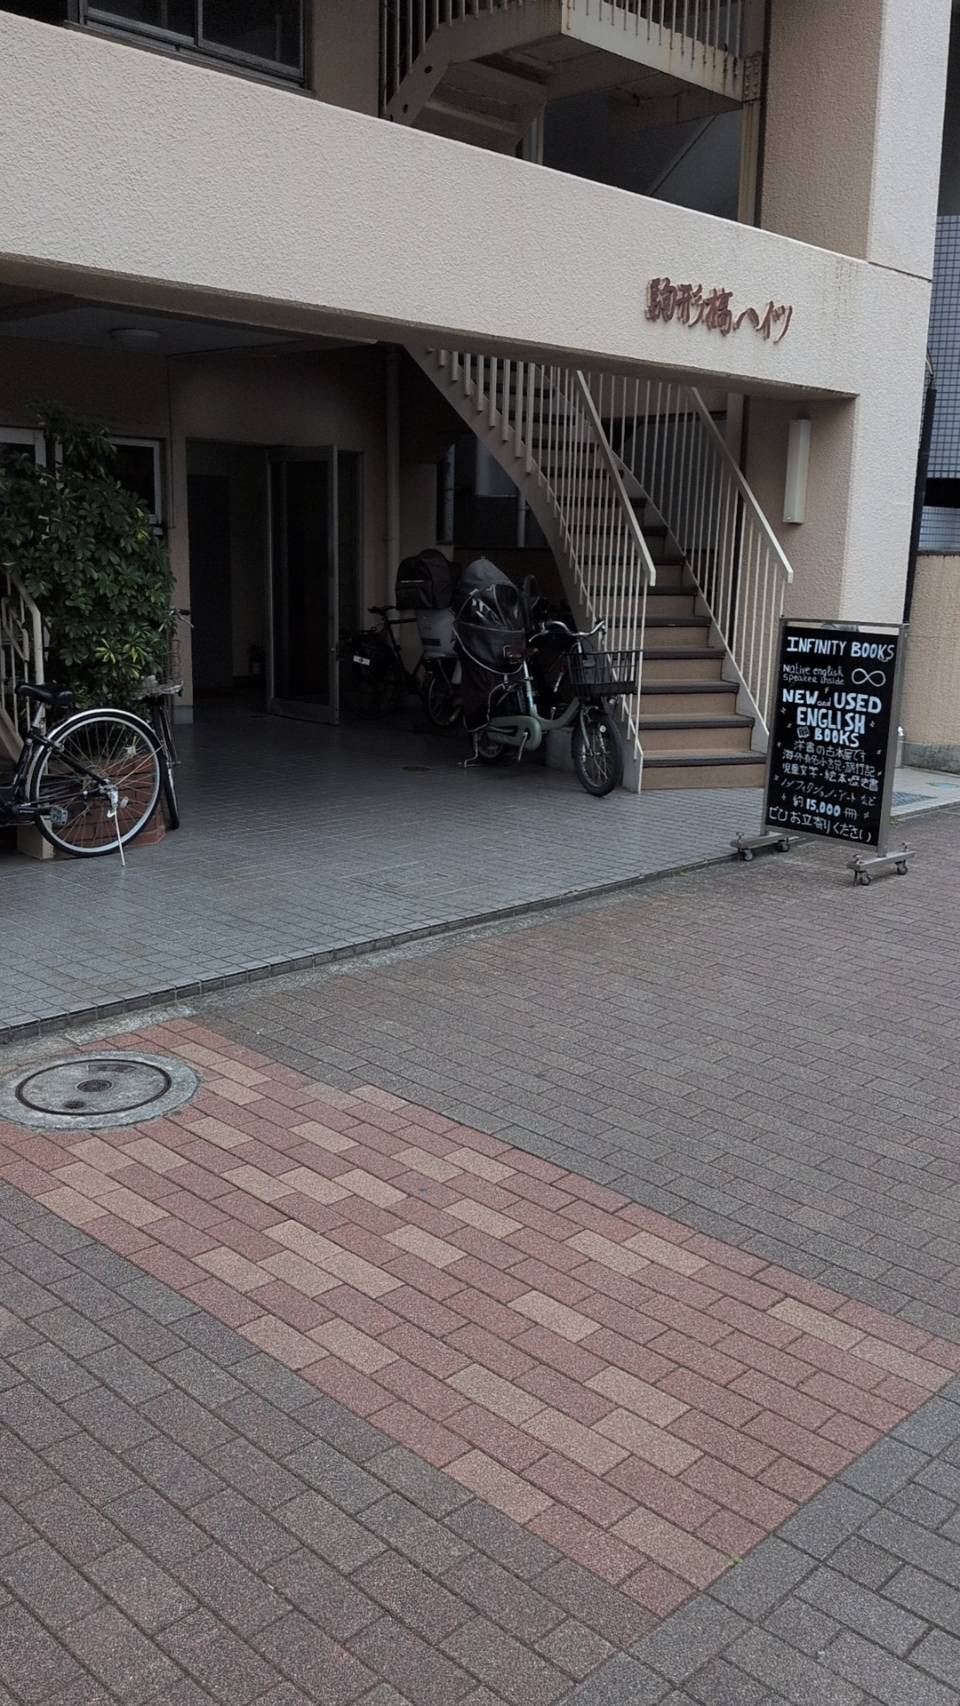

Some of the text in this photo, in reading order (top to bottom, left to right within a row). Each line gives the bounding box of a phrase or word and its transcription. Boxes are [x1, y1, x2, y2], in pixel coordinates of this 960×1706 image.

[786, 636, 895, 662] INFINITY BOOKS
[812, 665, 844, 678] english
[782, 688, 819, 705] NEW
[834, 692, 882, 714] USED
[797, 706, 866, 734] ENGLISH
[814, 728, 860, 747] BOOKS
